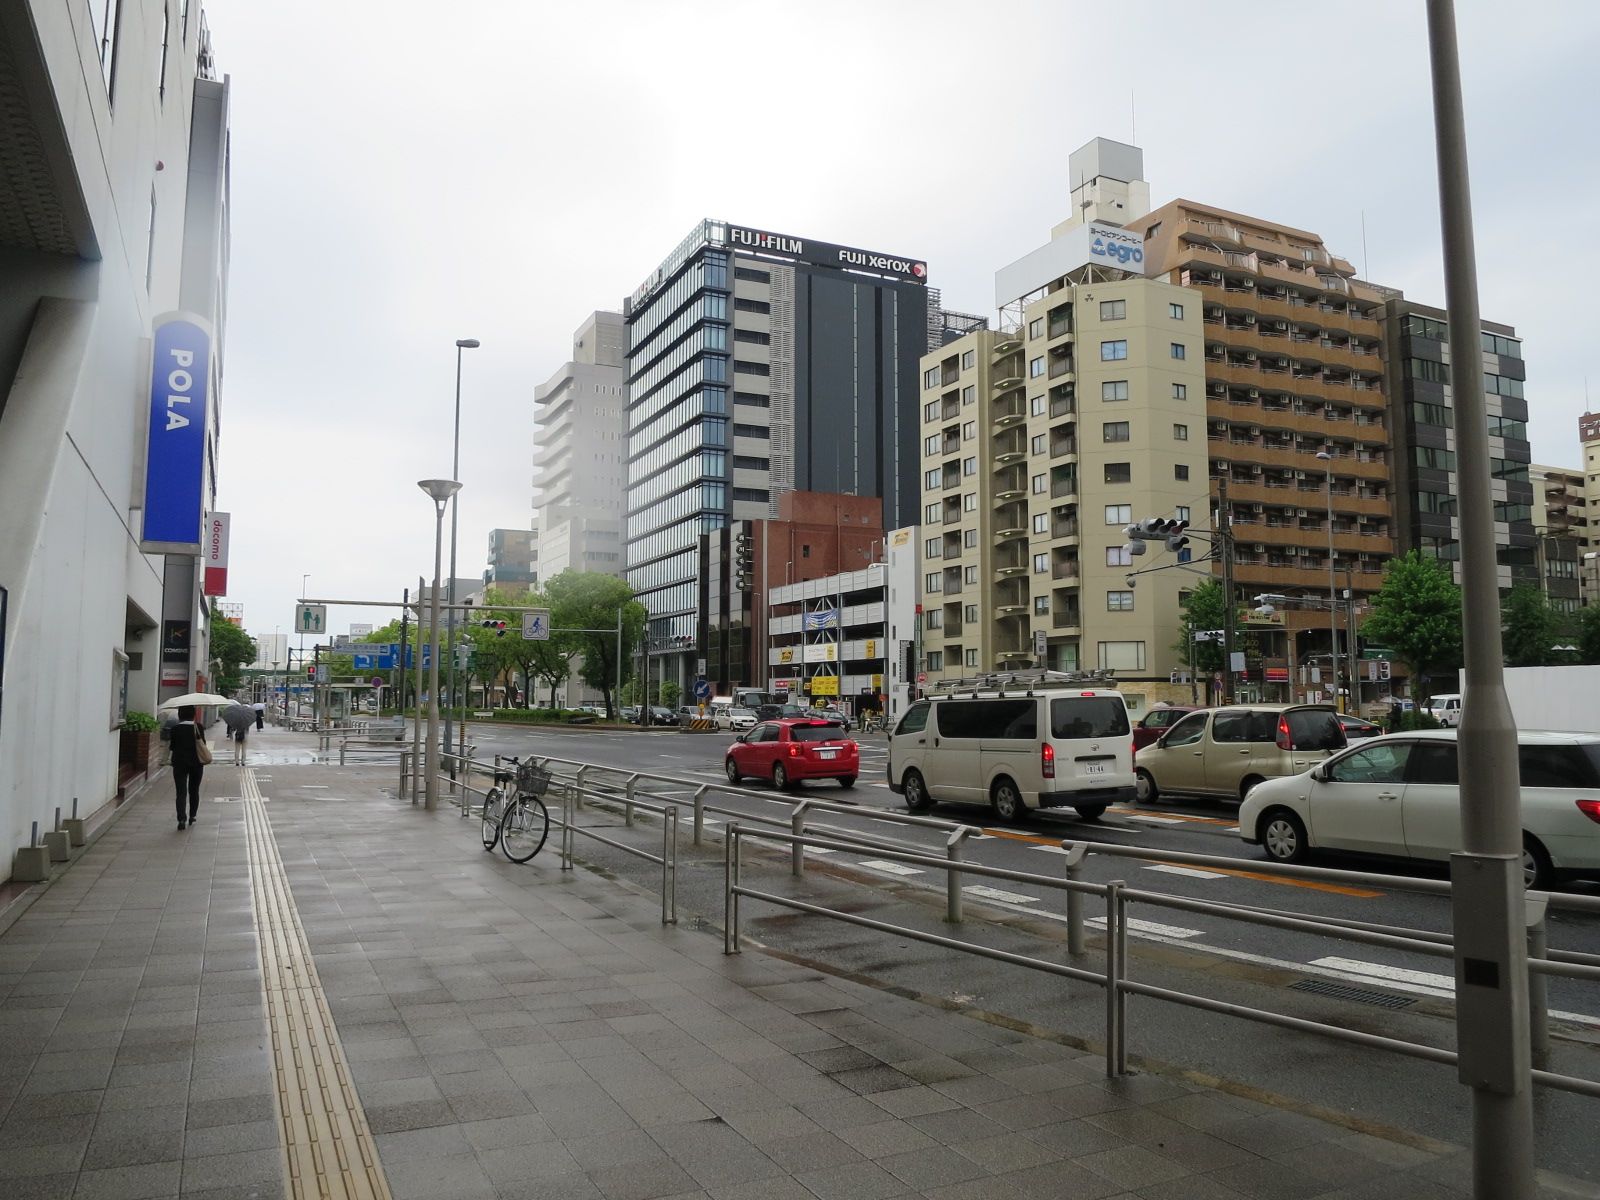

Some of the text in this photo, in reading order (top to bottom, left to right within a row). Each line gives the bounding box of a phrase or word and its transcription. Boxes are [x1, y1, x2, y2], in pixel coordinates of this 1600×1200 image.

[731, 228, 802, 254] FUJIFILM
[1090, 227, 1143, 244] ヨーロピアンコーヒー
[838, 250, 866, 265] FUJI
[1107, 241, 1143, 264] egro
[166, 348, 194, 431] POLA
[211, 520, 223, 560] docomo
